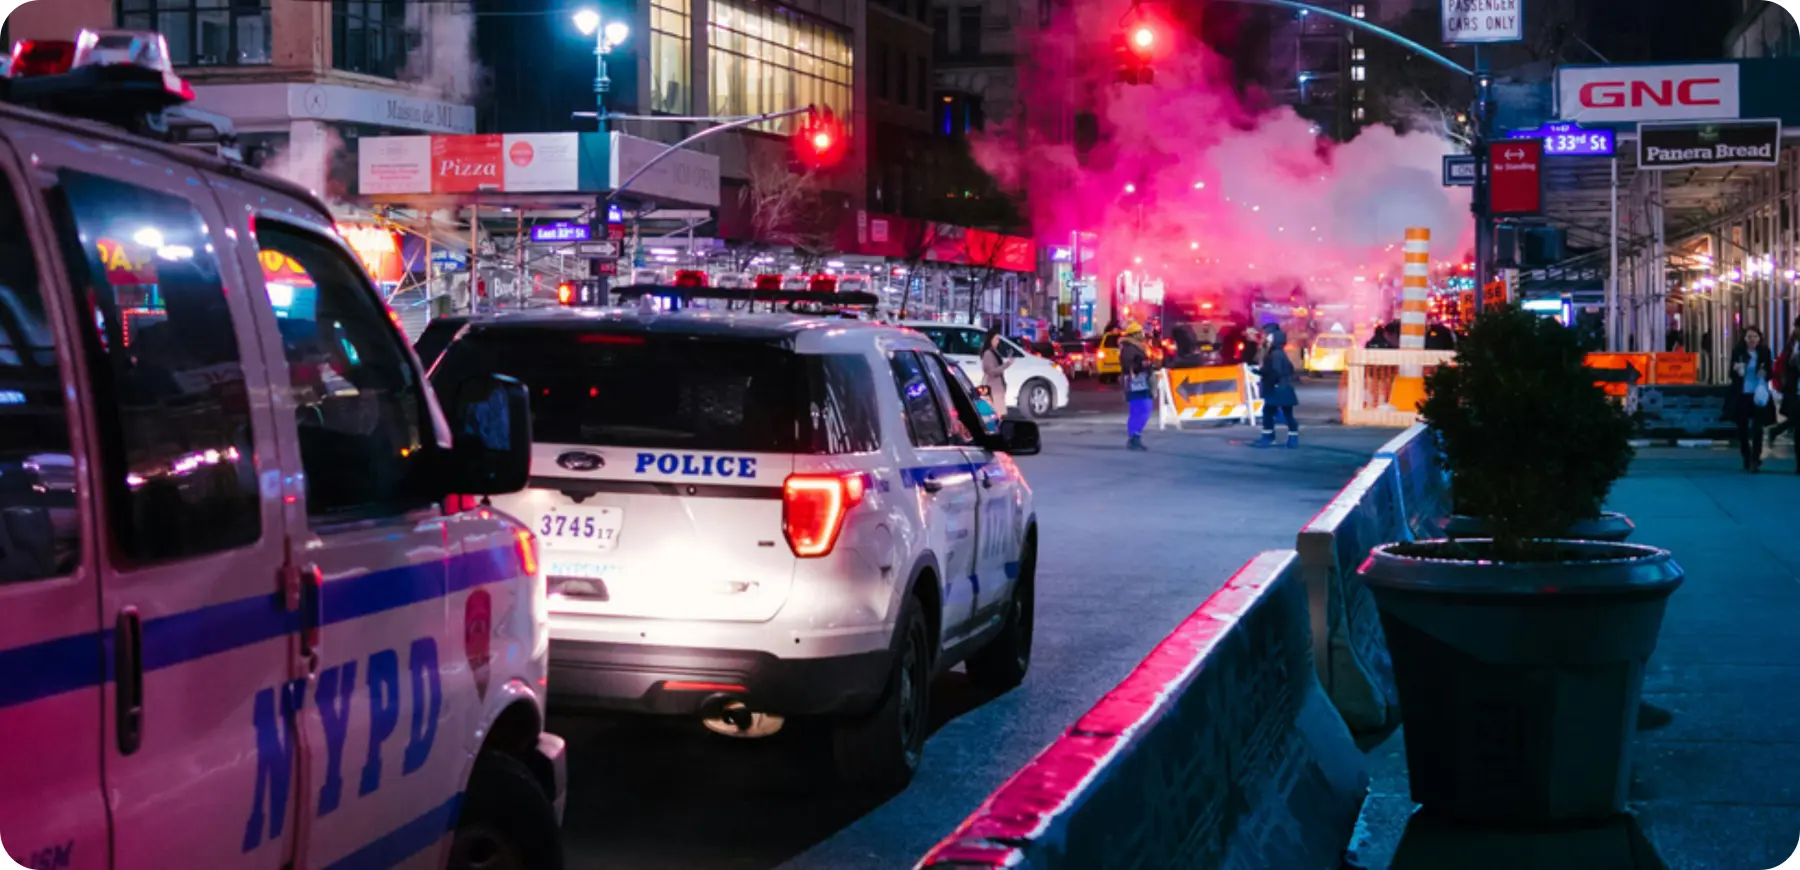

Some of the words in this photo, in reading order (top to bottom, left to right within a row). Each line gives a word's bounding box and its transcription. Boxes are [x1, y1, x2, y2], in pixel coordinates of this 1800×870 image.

[1449, 0, 1515, 12] PASSENGER
[1448, 16, 1479, 31] CARS
[1486, 15, 1515, 30] ONLY
[1579, 78, 1721, 108] GNC
[1557, 134, 1587, 151] 33rd
[1590, 134, 1607, 150] St
[1647, 145, 1713, 162] Panera
[1715, 143, 1772, 159] Bread
[440, 158, 497, 177] Pizza
[537, 228, 557, 239] East
[575, 228, 586, 239] St
[634, 452, 758, 478] POLICE
[540, 513, 595, 539] 3745
[597, 528, 614, 540] 17
[241, 636, 443, 854] NYPD
